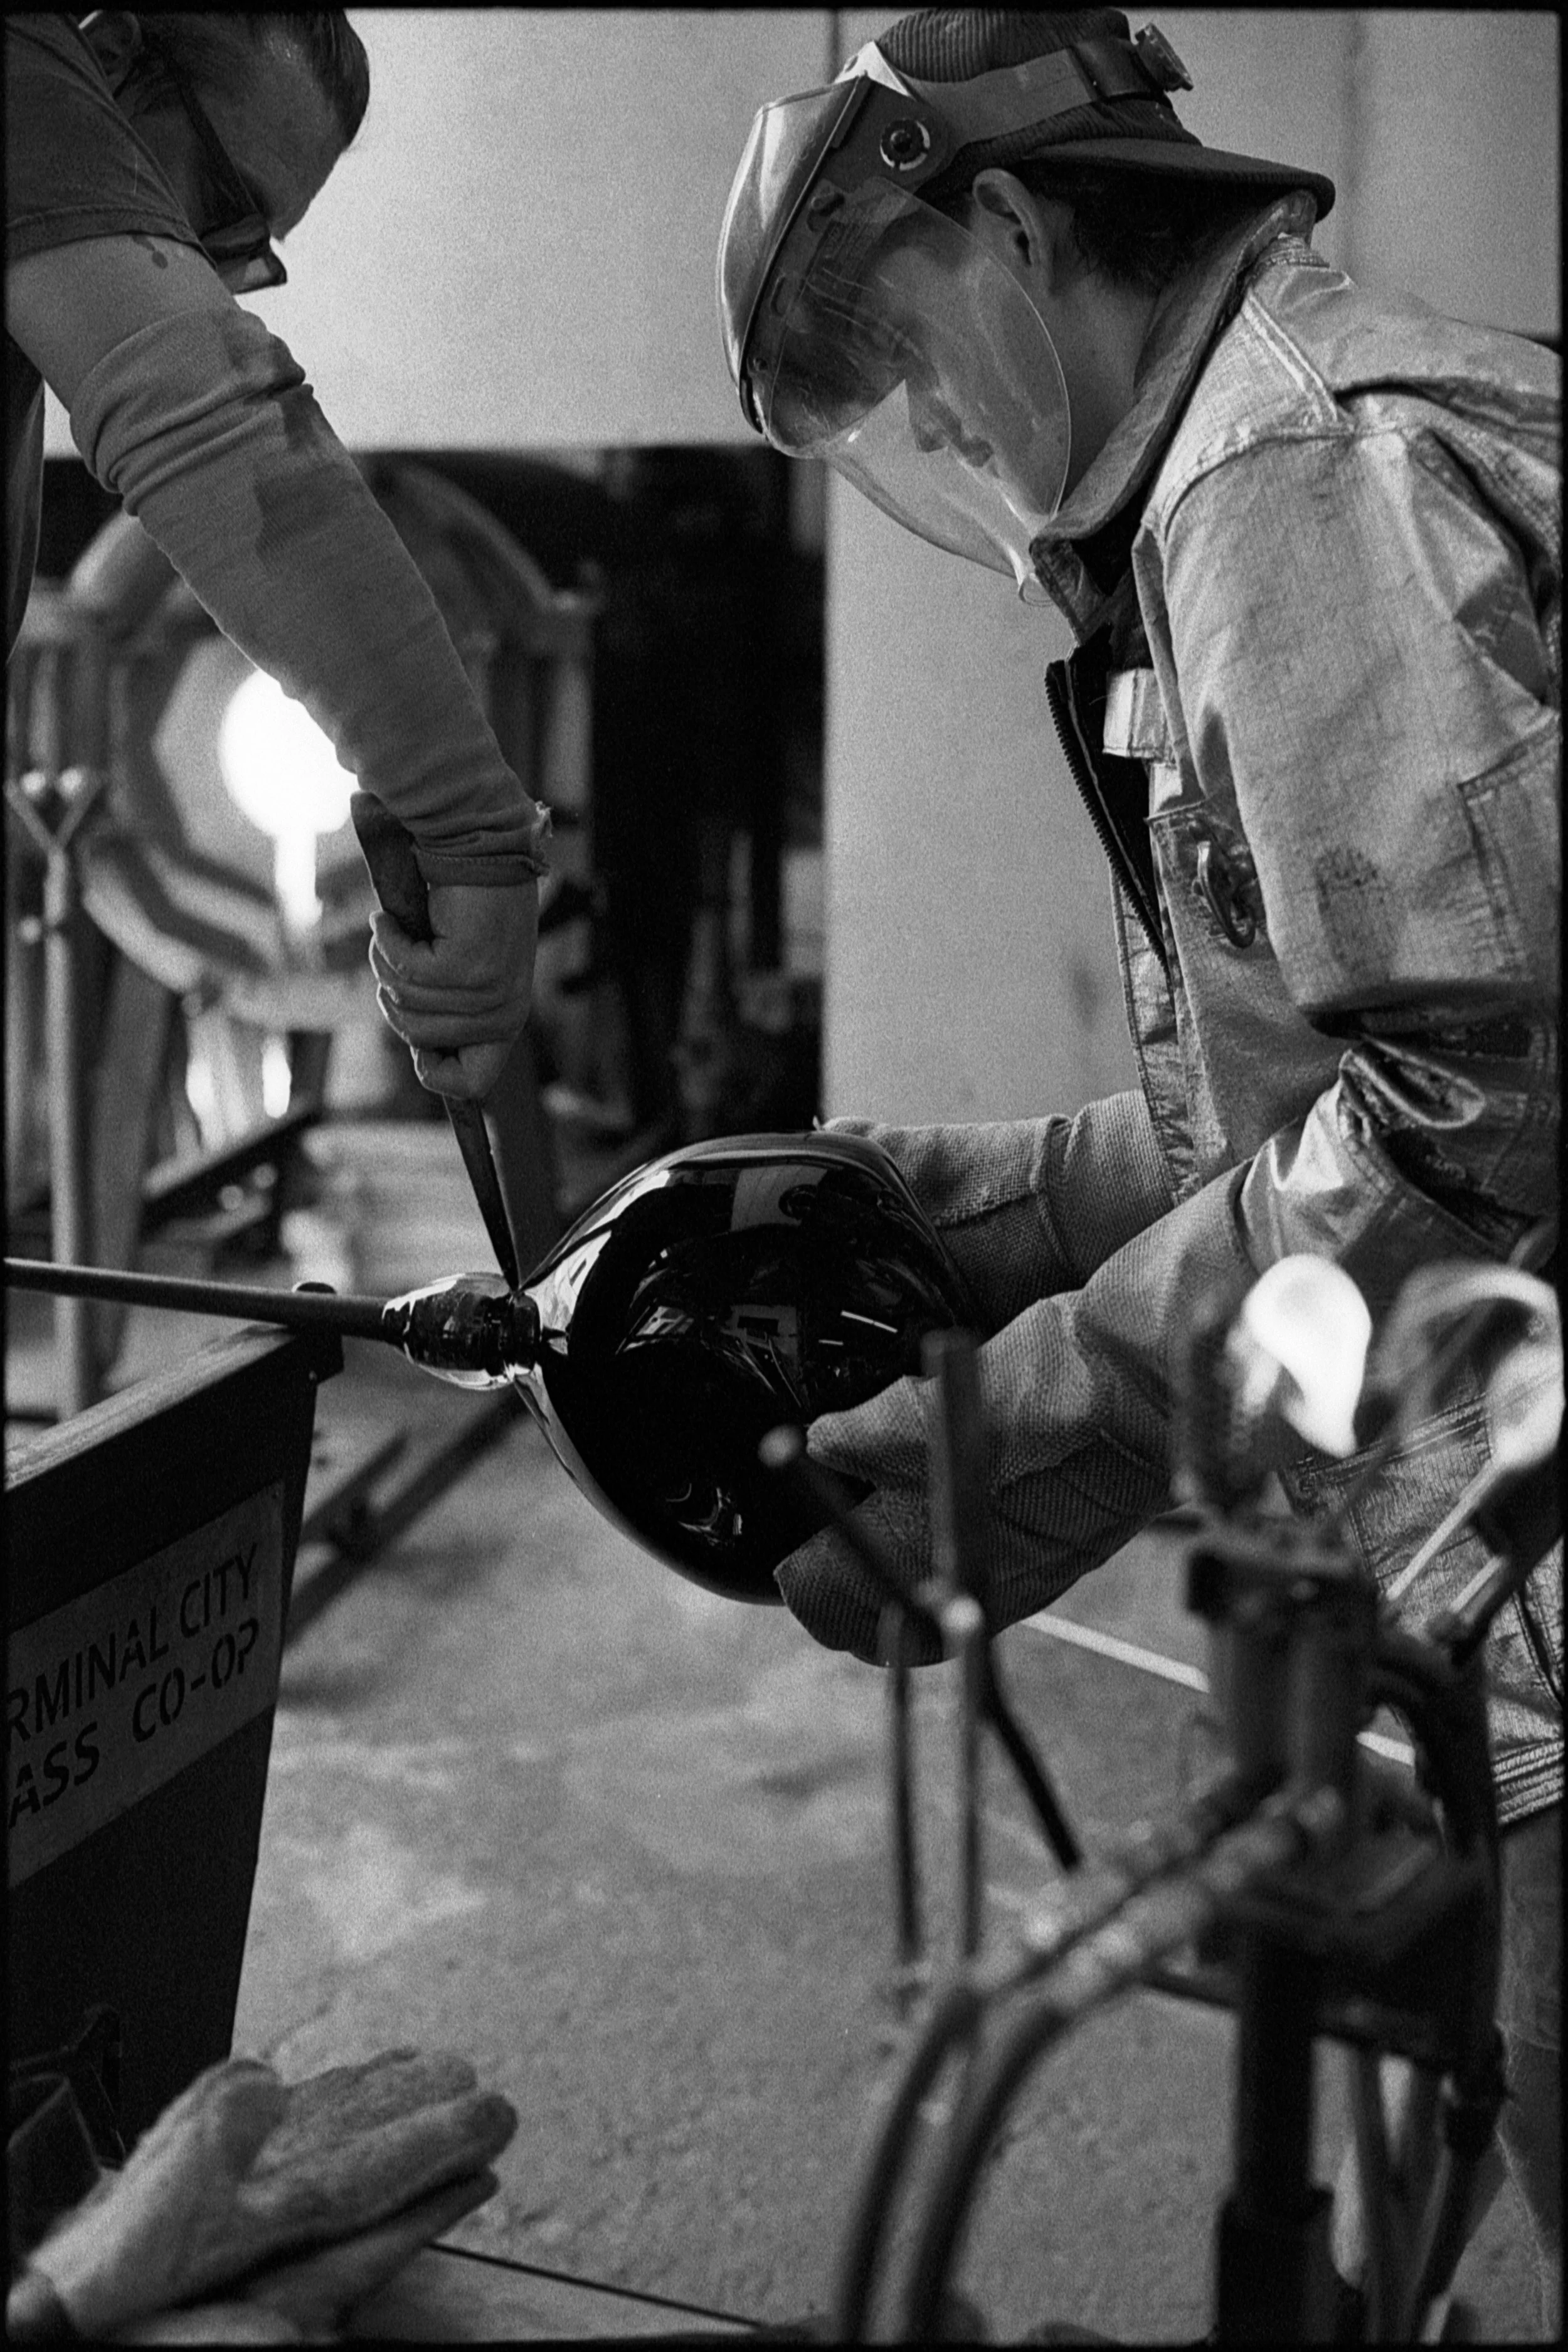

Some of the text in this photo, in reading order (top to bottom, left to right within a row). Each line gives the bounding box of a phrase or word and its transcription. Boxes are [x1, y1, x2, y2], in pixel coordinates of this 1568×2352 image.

[8, 1542, 257, 1742] RMINAL CITY
[8, 1617, 259, 1829] ASS CO-OP
